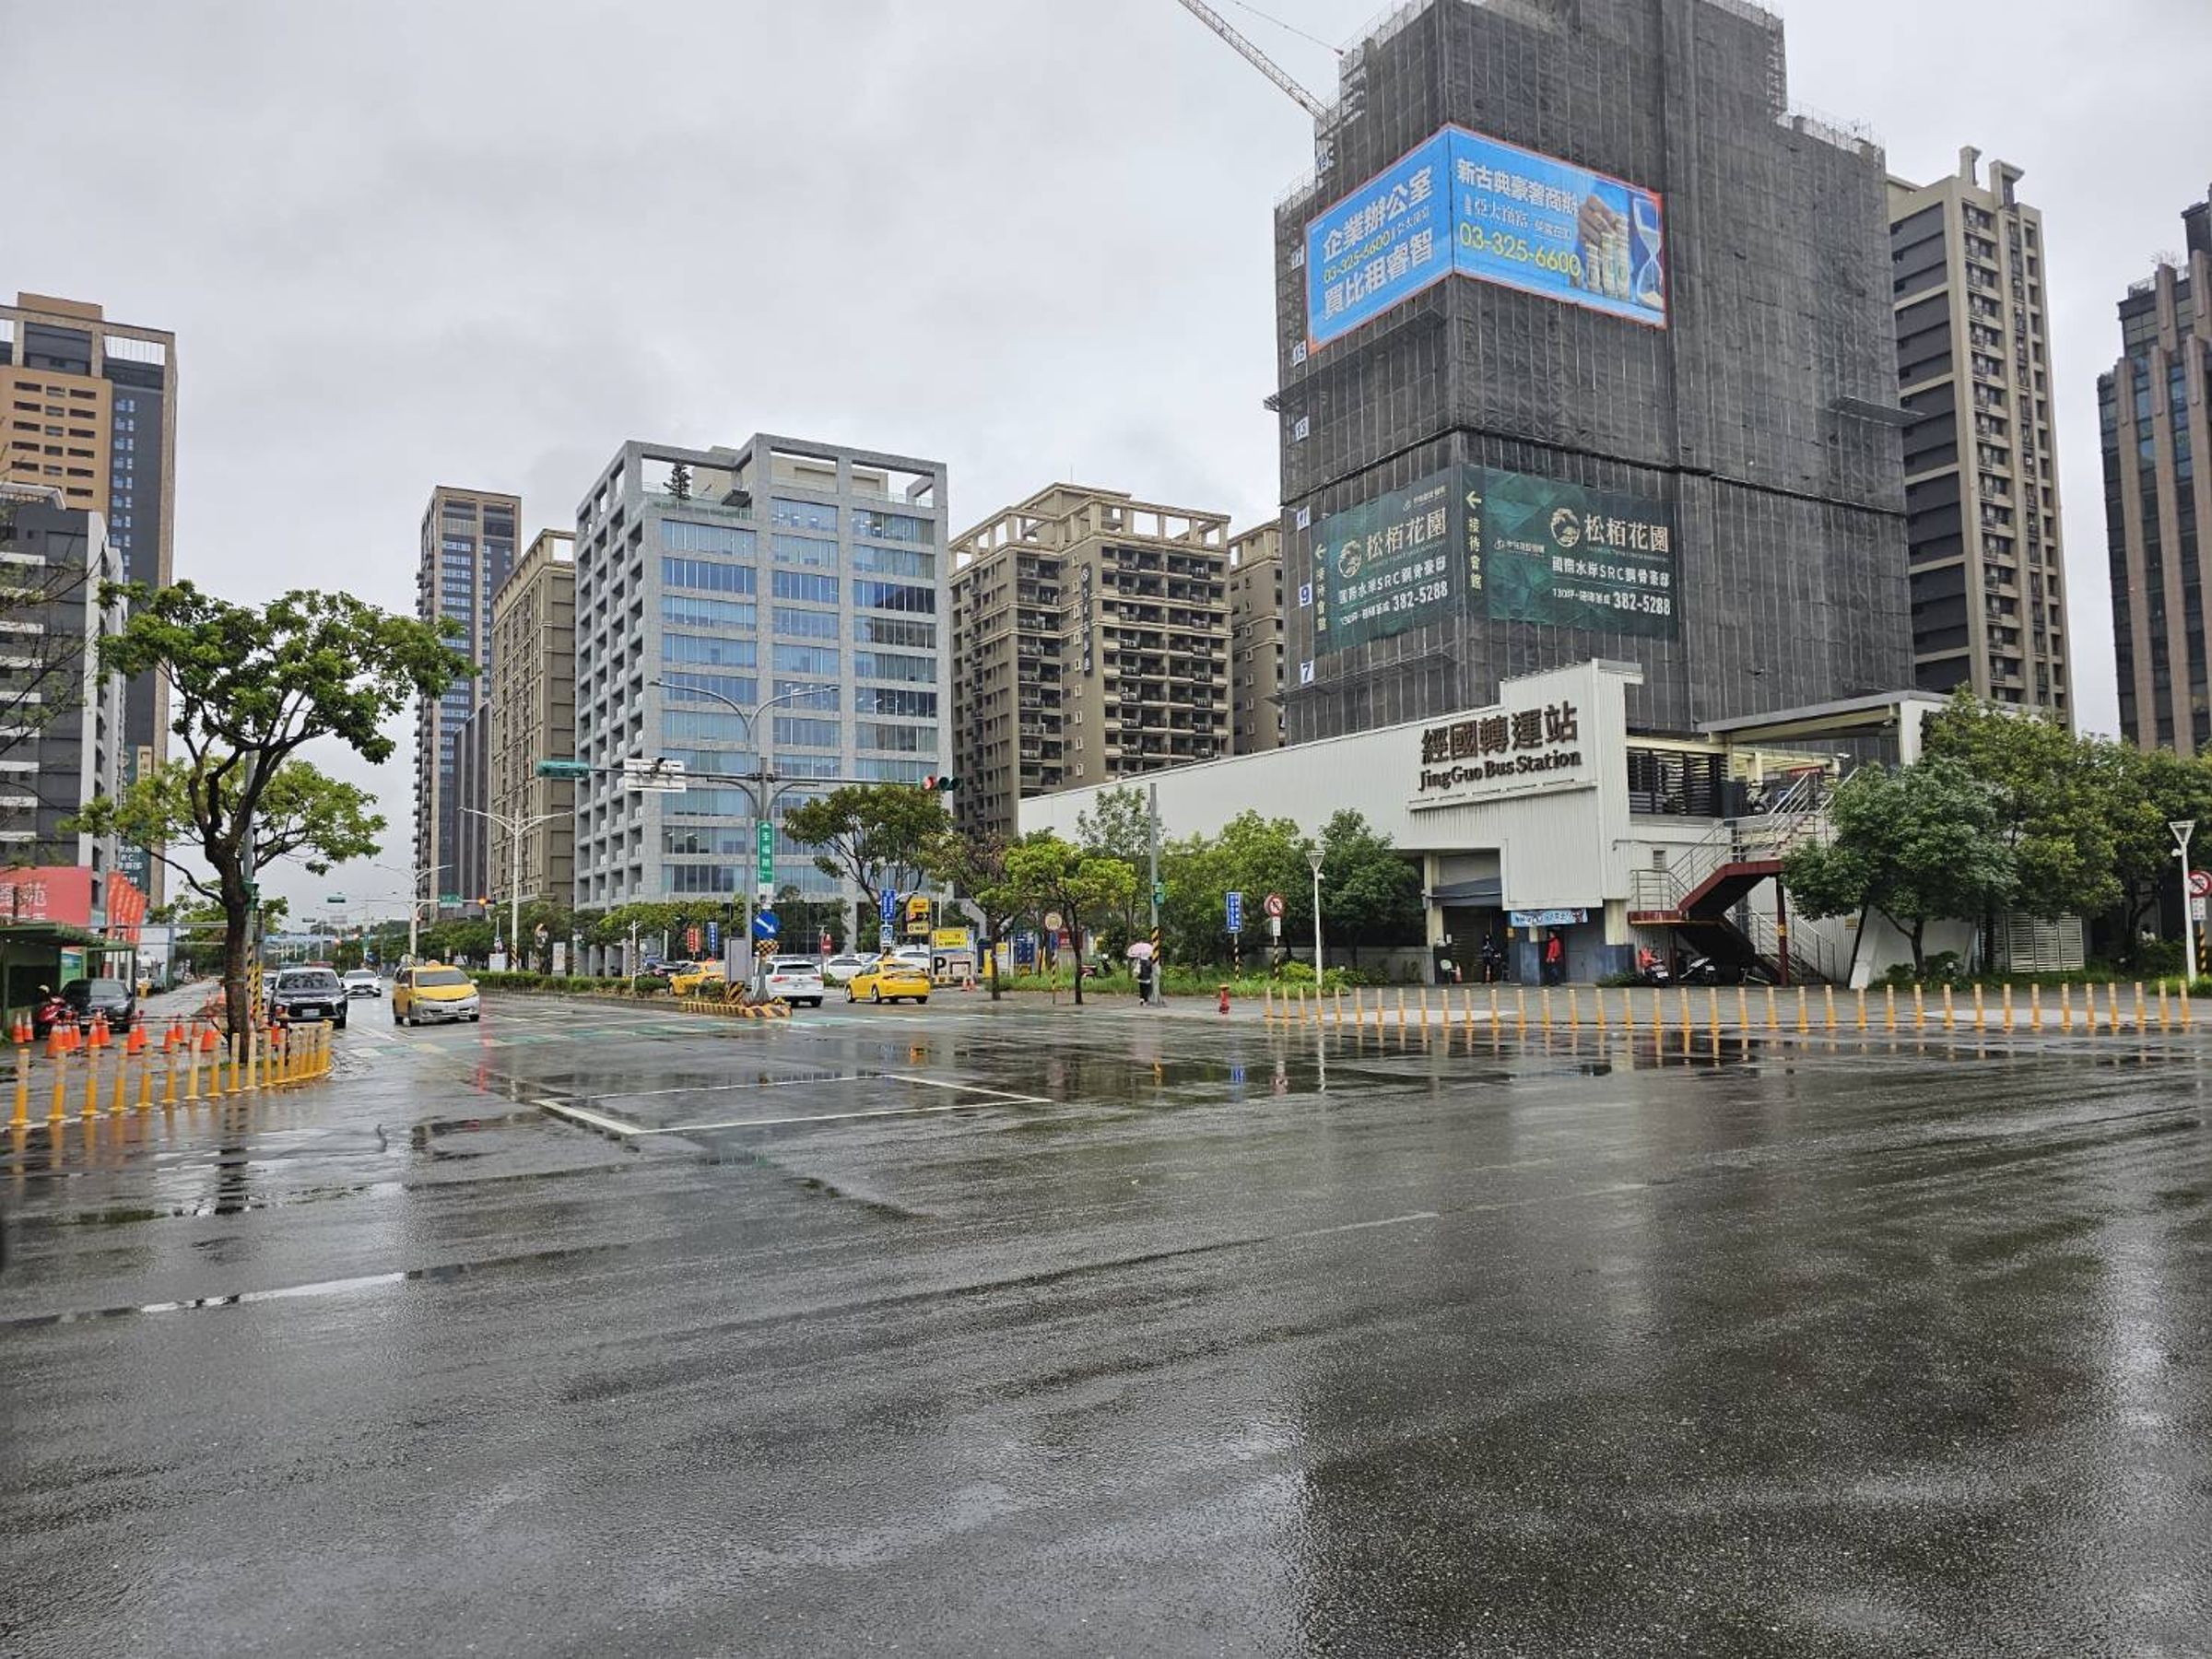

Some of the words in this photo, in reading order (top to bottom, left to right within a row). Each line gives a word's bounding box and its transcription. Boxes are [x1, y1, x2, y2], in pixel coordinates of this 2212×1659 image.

[1324, 165, 1433, 263] 企業辦公室
[1323, 229, 1392, 285] 03-325-6600
[1459, 221, 1582, 276] 03-325-6600
[1324, 227, 1433, 321] 買比租睿智
[1301, 587, 1310, 603] 9
[1394, 581, 1448, 611] 382-5288
[1613, 591, 1671, 616] 382-5288
[1421, 700, 1578, 765] 經國轉運站
[1418, 766, 1482, 792] JingGuo
[1485, 759, 1514, 779] Bus
[1516, 749, 1582, 774] Station
[935, 957, 947, 975] P
